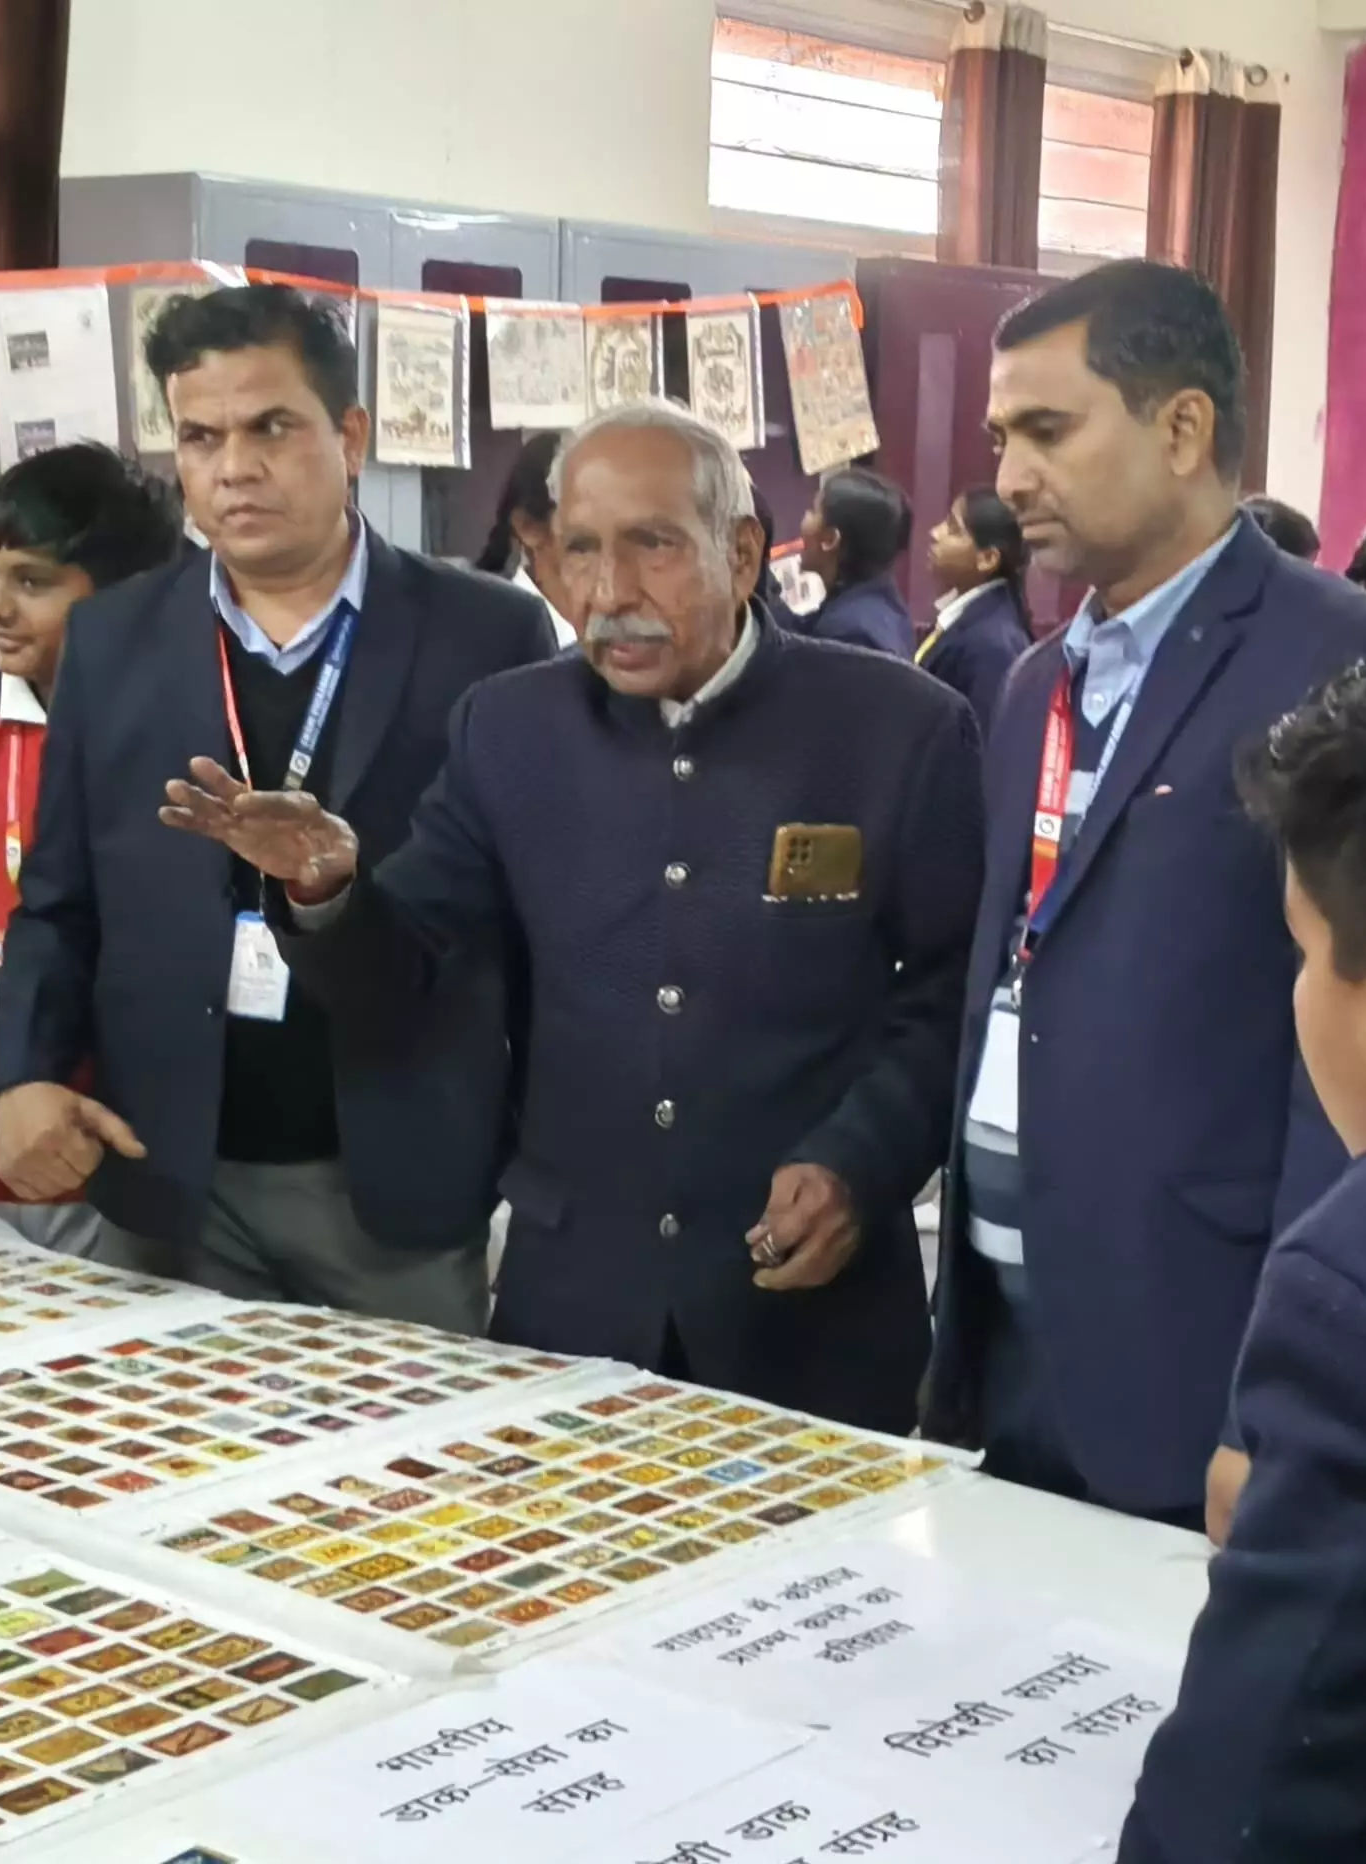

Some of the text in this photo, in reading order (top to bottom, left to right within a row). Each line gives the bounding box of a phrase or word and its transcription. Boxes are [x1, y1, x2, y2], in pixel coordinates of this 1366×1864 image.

[856, 1586, 903, 1604] का
[814, 1619, 915, 1663] इतिहास
[376, 1717, 514, 1771] भारतीय
[565, 1718, 629, 1743] का
[884, 1700, 1014, 1757] विदेशी
[1004, 1692, 1162, 1764] का संग्रह
[521, 1772, 626, 1814] संग्रह
[724, 1798, 811, 1840] डाक
[819, 1808, 920, 1855] संग्रह
